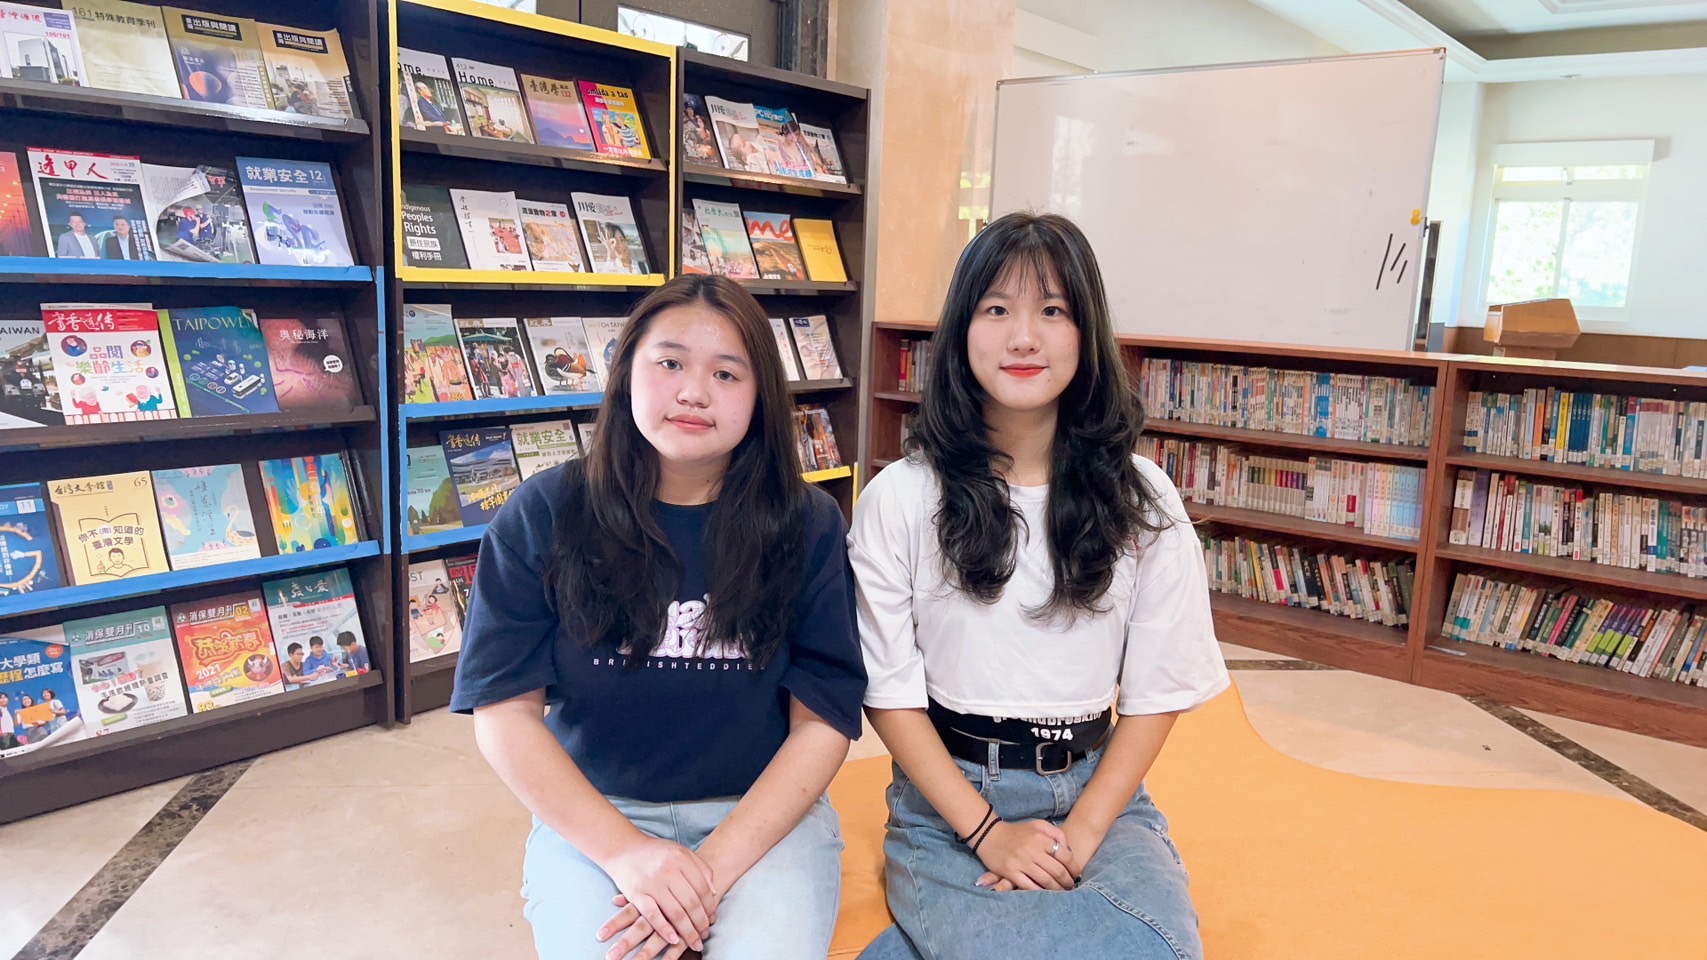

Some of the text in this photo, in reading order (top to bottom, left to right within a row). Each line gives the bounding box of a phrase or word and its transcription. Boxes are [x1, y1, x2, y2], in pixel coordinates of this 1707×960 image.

[95, 11, 156, 29] 特殊教育季刊
[192, 18, 237, 33] 出版與閱讀
[398, 61, 425, 76] ome.
[245, 165, 309, 184] 就業安全
[401, 203, 431, 212] ndigenous
[401, 210, 434, 223] Peoples
[403, 222, 437, 236] Rights
[0, 326, 40, 335] AIWAN
[279, 328, 329, 341] 奧秘海洋
[89, 345, 124, 360] 品閱
[75, 360, 144, 375] 樂齡生活
[516, 428, 566, 447] 就業安全
[92, 536, 134, 550] 臺灣文學
[189, 605, 249, 622] 消保雙月刊 02
[85, 623, 150, 641] 消保雙月刊 10
[0, 652, 41, 671] 大學類
[593, 658, 765, 671] BRIISHTEDDIE
[196, 664, 222, 680] 2021
[1030, 727, 1074, 741] 1974
